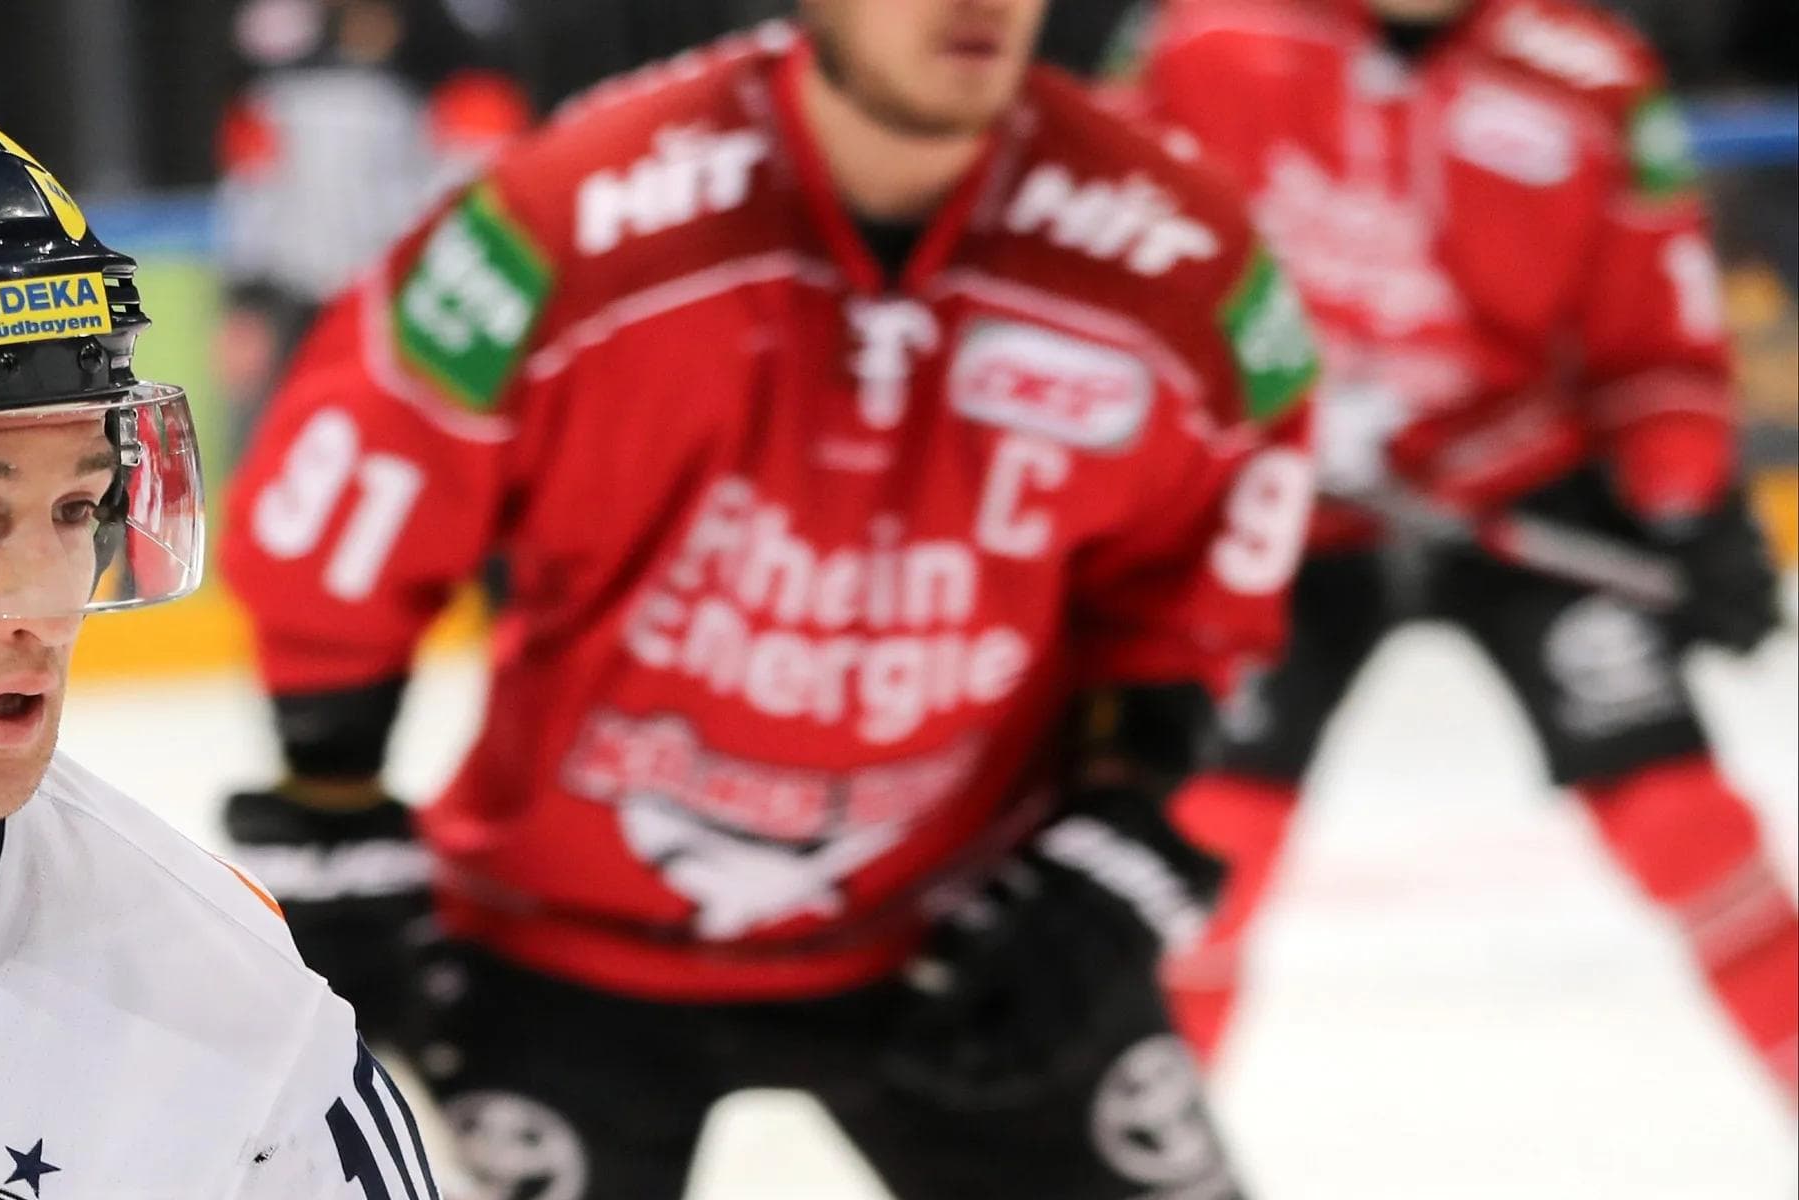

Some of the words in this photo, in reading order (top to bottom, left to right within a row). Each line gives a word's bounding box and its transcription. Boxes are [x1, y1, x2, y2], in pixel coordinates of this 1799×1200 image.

[252, 406, 424, 600] 91
[669, 473, 981, 625] Rhein
[976, 436, 1071, 558] C
